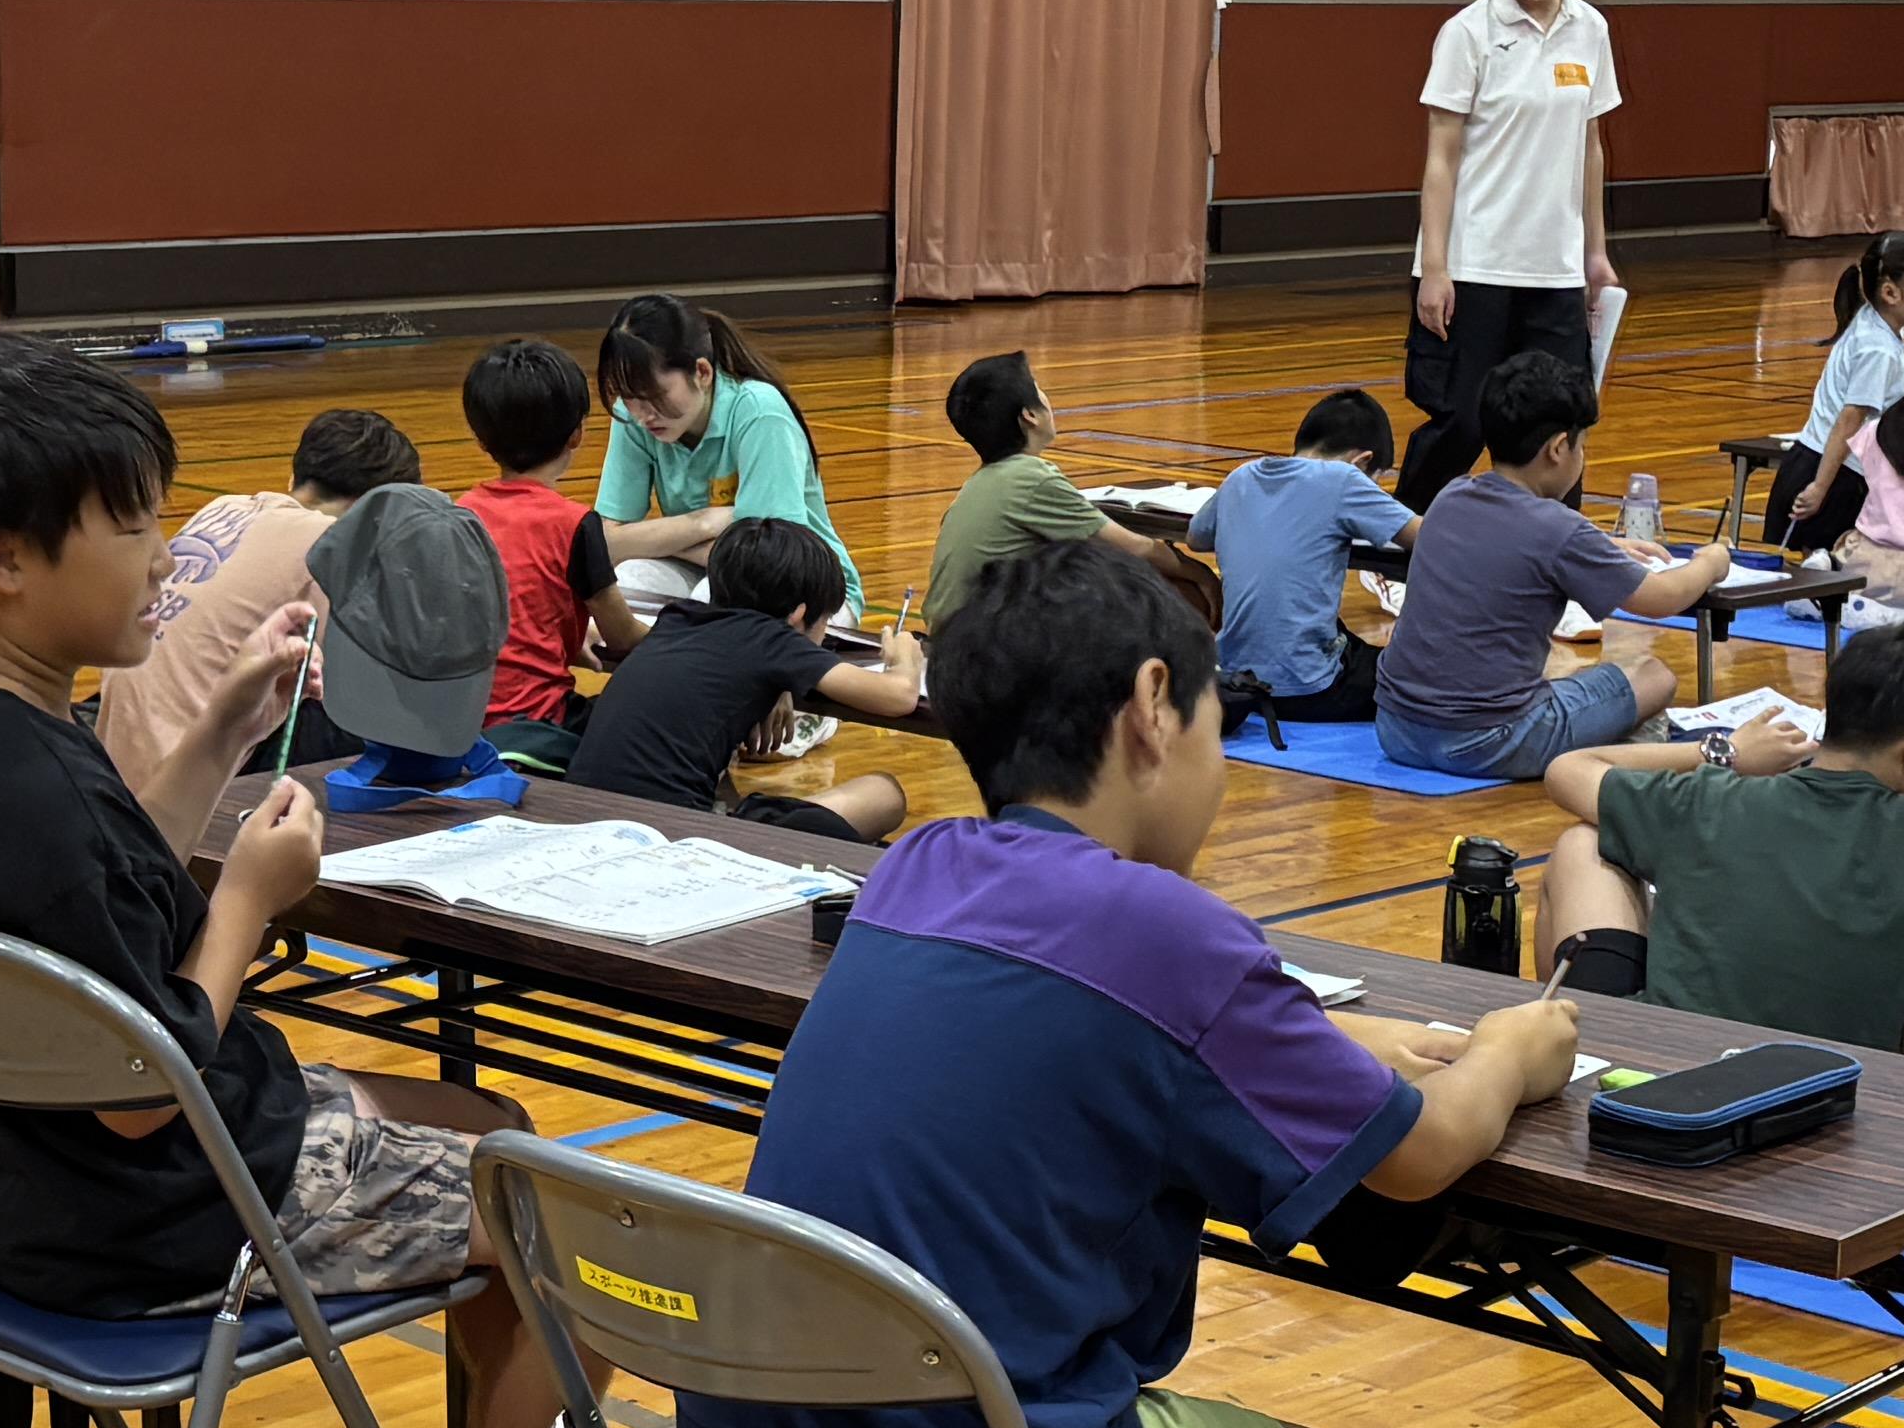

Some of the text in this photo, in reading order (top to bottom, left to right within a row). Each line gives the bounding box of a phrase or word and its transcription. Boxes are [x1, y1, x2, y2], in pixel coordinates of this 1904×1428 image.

[587, 1267, 685, 1311] スポーツ推進課
